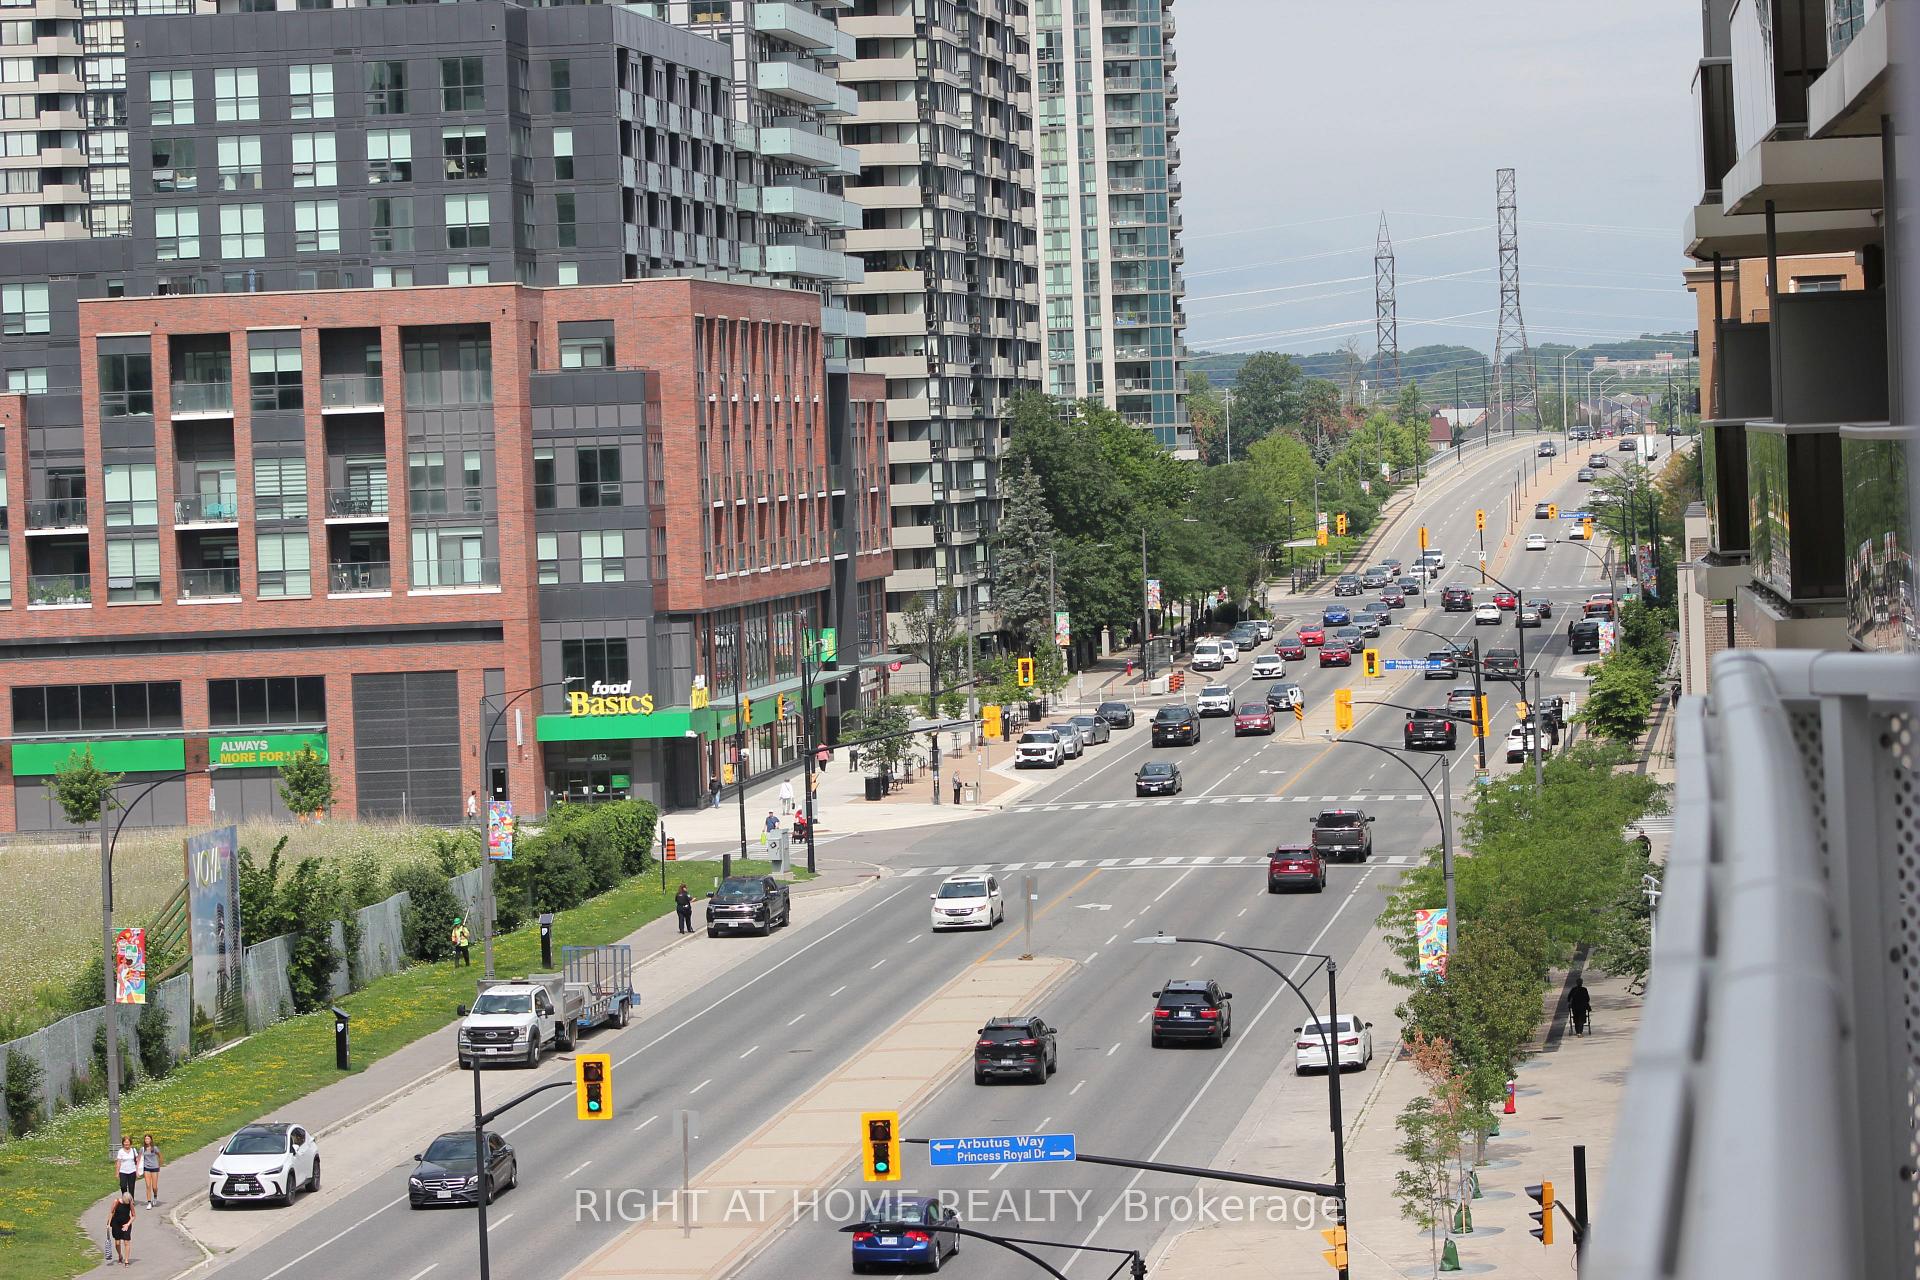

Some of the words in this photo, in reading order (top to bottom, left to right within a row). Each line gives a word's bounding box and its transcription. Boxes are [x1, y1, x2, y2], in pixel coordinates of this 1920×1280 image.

[591, 679, 632, 695] food
[220, 740, 268, 752] ALWAYS
[220, 752, 257, 764] MORE
[259, 751, 284, 762] FOR
[591, 753, 607, 761] 4152
[957, 1138, 1010, 1150] Arbutus
[1016, 1136, 1045, 1148] Way
[957, 1150, 1001, 1162] Princess
[1003, 1149, 1032, 1162] Royal
[1034, 1149, 1046, 1159] Dr
